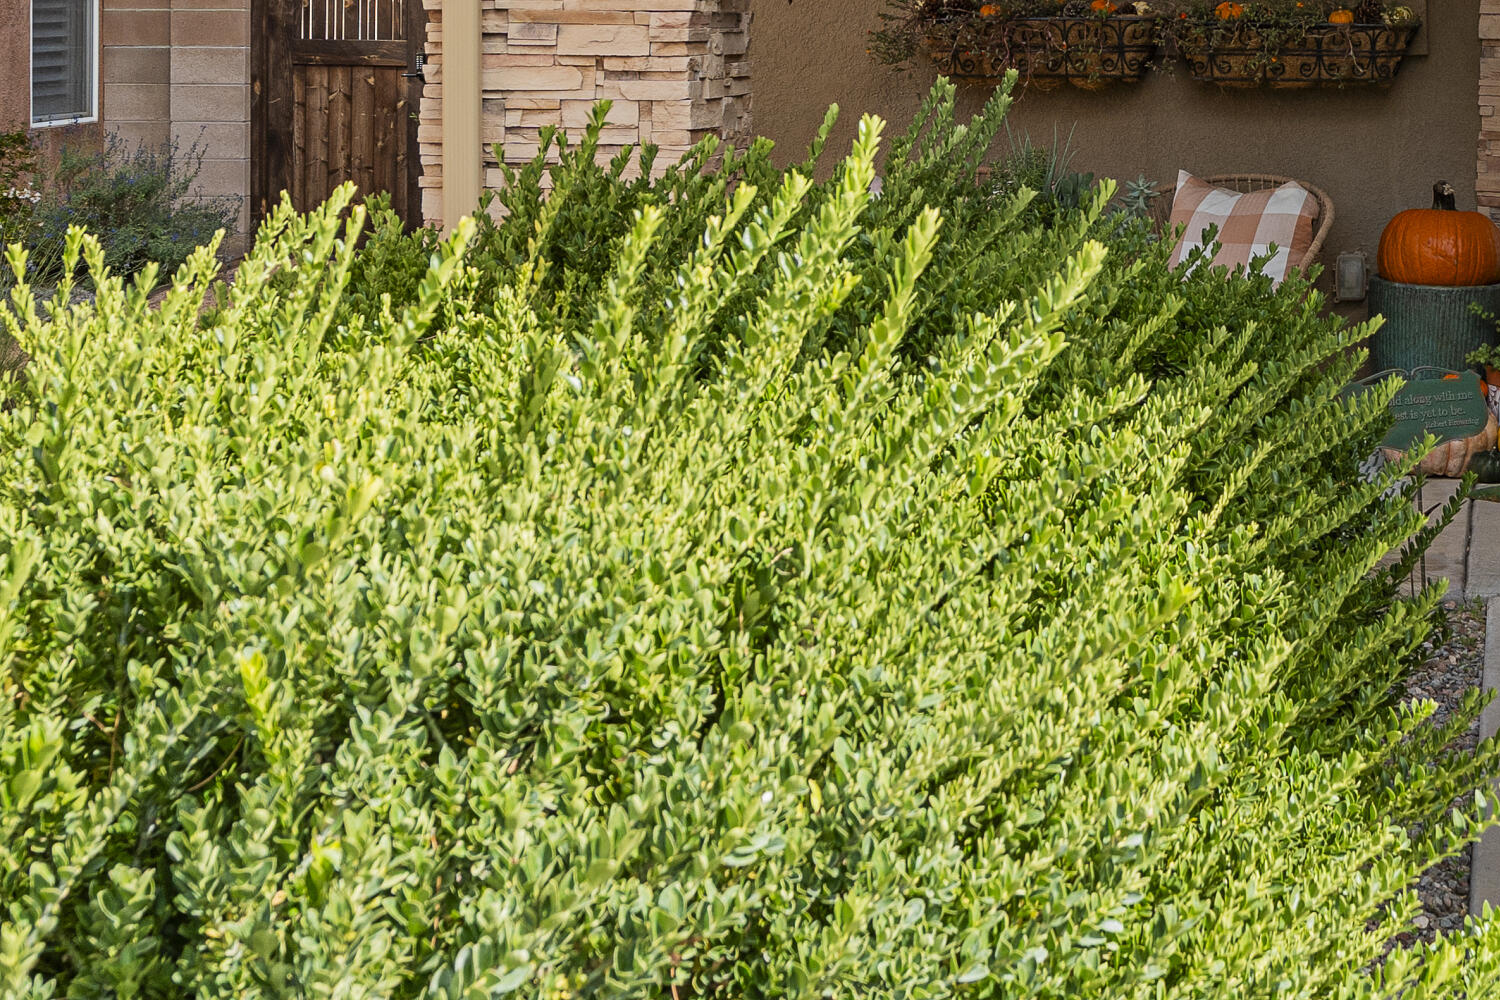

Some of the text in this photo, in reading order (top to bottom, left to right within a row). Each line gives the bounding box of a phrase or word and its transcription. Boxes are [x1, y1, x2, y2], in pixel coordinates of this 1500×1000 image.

[1404, 394, 1432, 405] along
[1433, 391, 1454, 401] with
[1457, 391, 1473, 400] me
[1393, 410, 1409, 420] est
[1410, 409, 1419, 419] is
[1420, 407, 1437, 422] yet
[1438, 407, 1448, 417] to
[1424, 417, 1480, 428] Robert Browning
